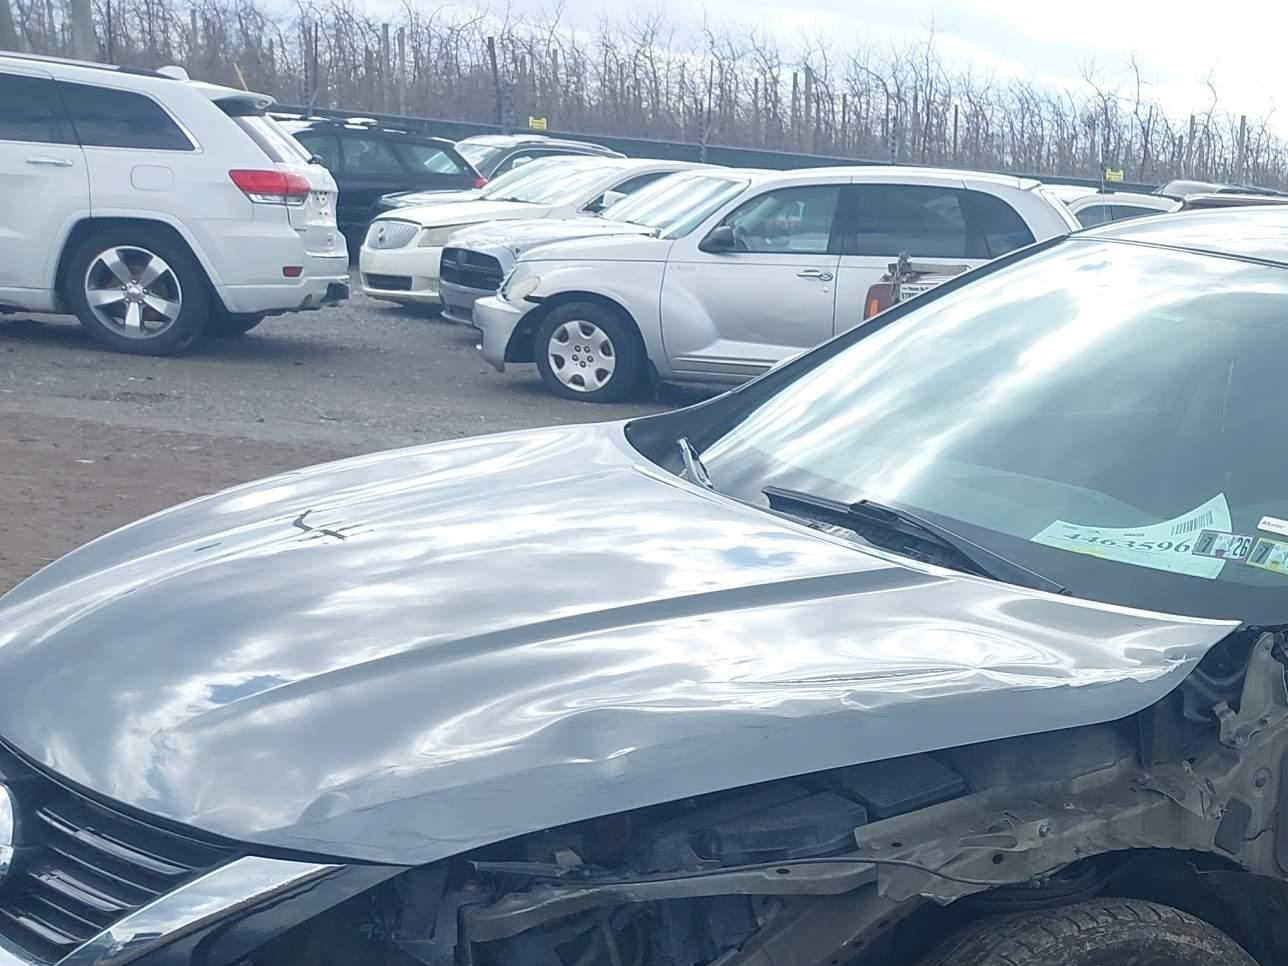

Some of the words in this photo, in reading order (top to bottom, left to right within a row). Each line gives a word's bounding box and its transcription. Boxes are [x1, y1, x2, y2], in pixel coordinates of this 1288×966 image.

[1062, 532, 1195, 554] 4463596
[1232, 537, 1251, 558] 26
[1255, 545, 1269, 564] 7
